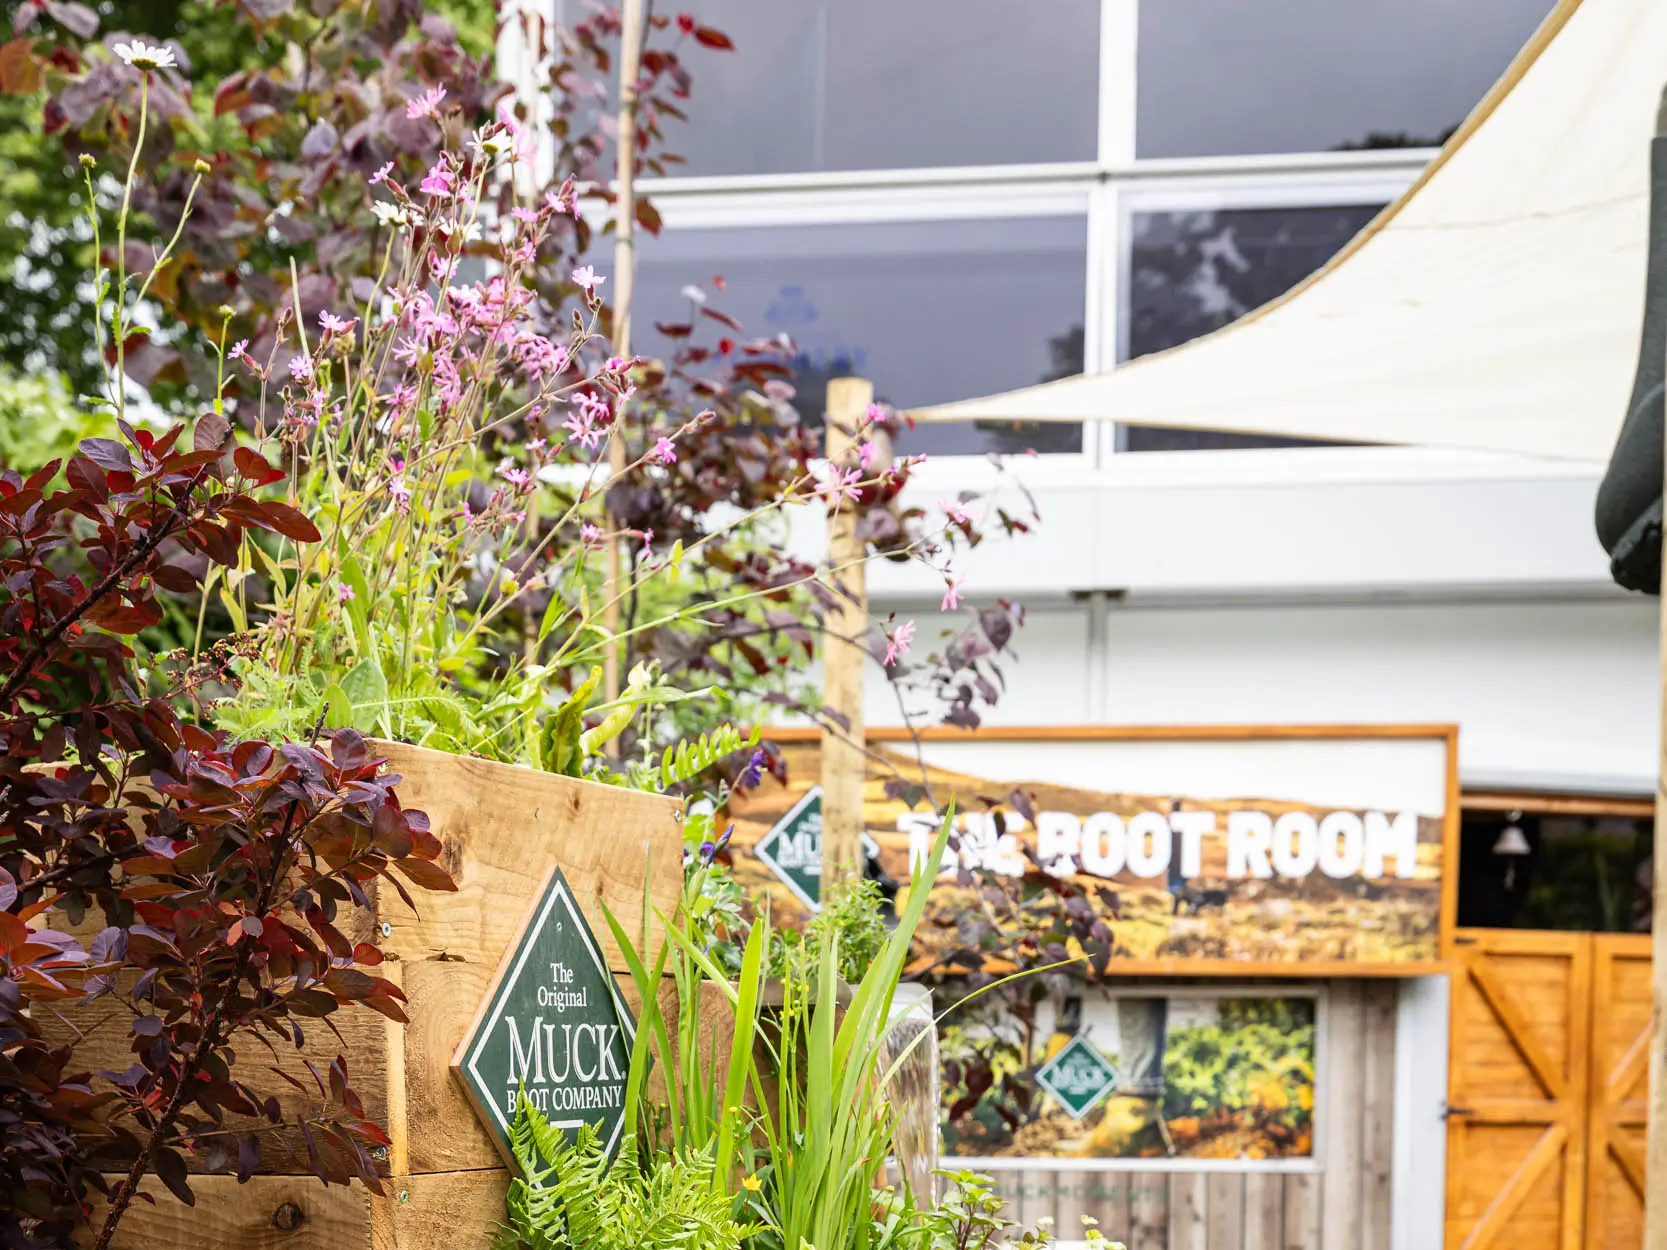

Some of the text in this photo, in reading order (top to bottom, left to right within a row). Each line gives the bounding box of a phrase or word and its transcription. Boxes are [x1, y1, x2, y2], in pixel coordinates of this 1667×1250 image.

[1037, 811, 1215, 878] BOOT
[1227, 811, 1418, 878] ROOM
[550, 963, 574, 984] The
[537, 986, 587, 1013] Original
[552, 1086, 622, 1111] COMPANY
